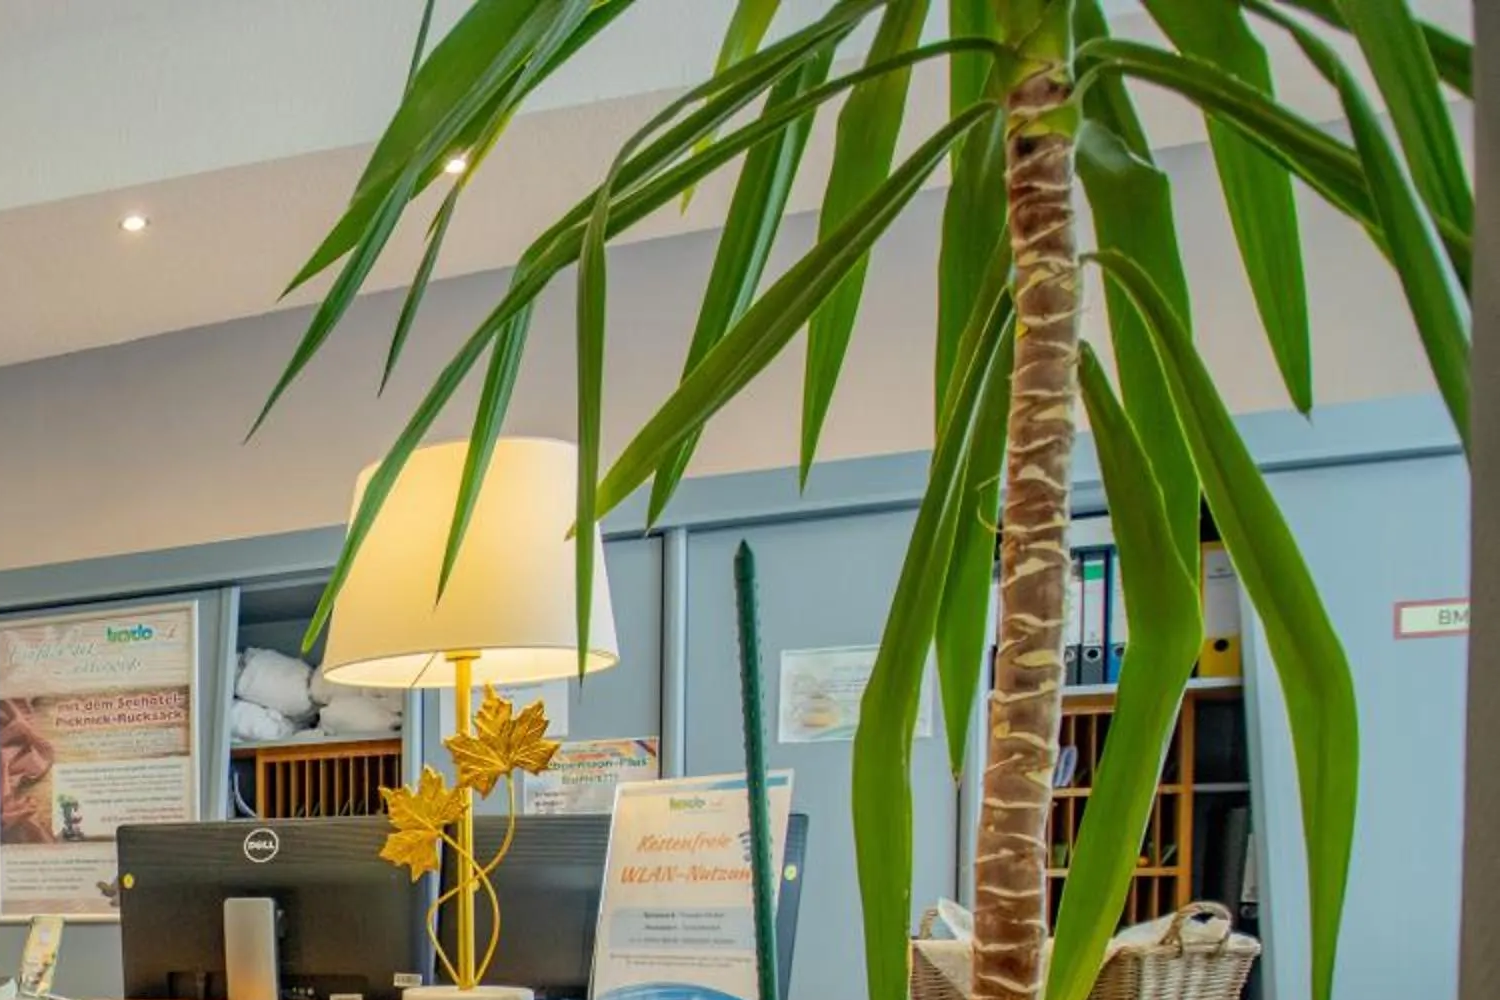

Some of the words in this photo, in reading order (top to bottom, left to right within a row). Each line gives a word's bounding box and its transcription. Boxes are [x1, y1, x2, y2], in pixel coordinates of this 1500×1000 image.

[1439, 608, 1470, 625] BM
[84, 698, 113, 711] dem
[117, 693, 185, 709] Seehotel-
[55, 710, 182, 727] Picknick-Rucksack
[248, 840, 275, 850] DELL
[636, 831, 733, 853] Kostenfreie
[621, 863, 751, 884] WLAN-Nutzun
